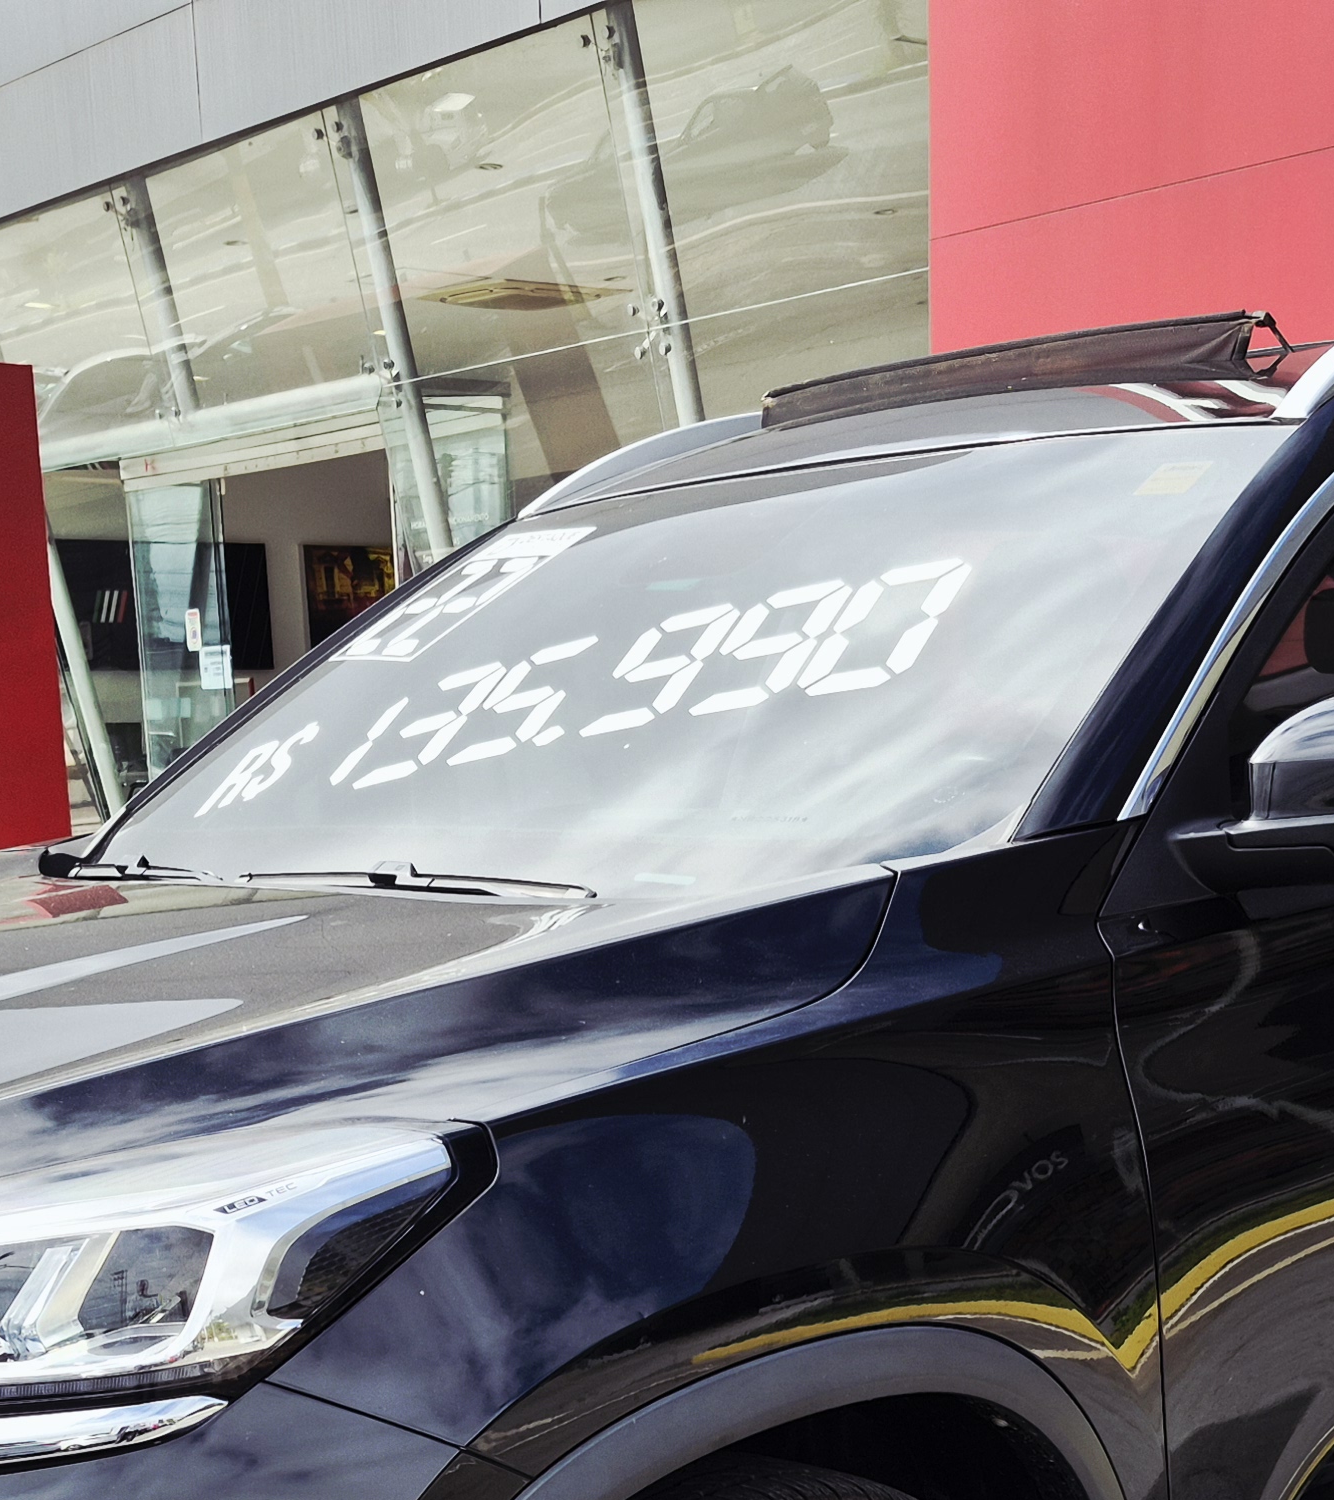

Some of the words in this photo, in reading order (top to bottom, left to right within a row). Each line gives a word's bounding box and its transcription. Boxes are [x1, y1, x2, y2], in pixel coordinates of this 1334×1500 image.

[331, 557, 972, 790] 135.990
[223, 1195, 260, 1214] LED
[265, 1182, 298, 1197] TEC
